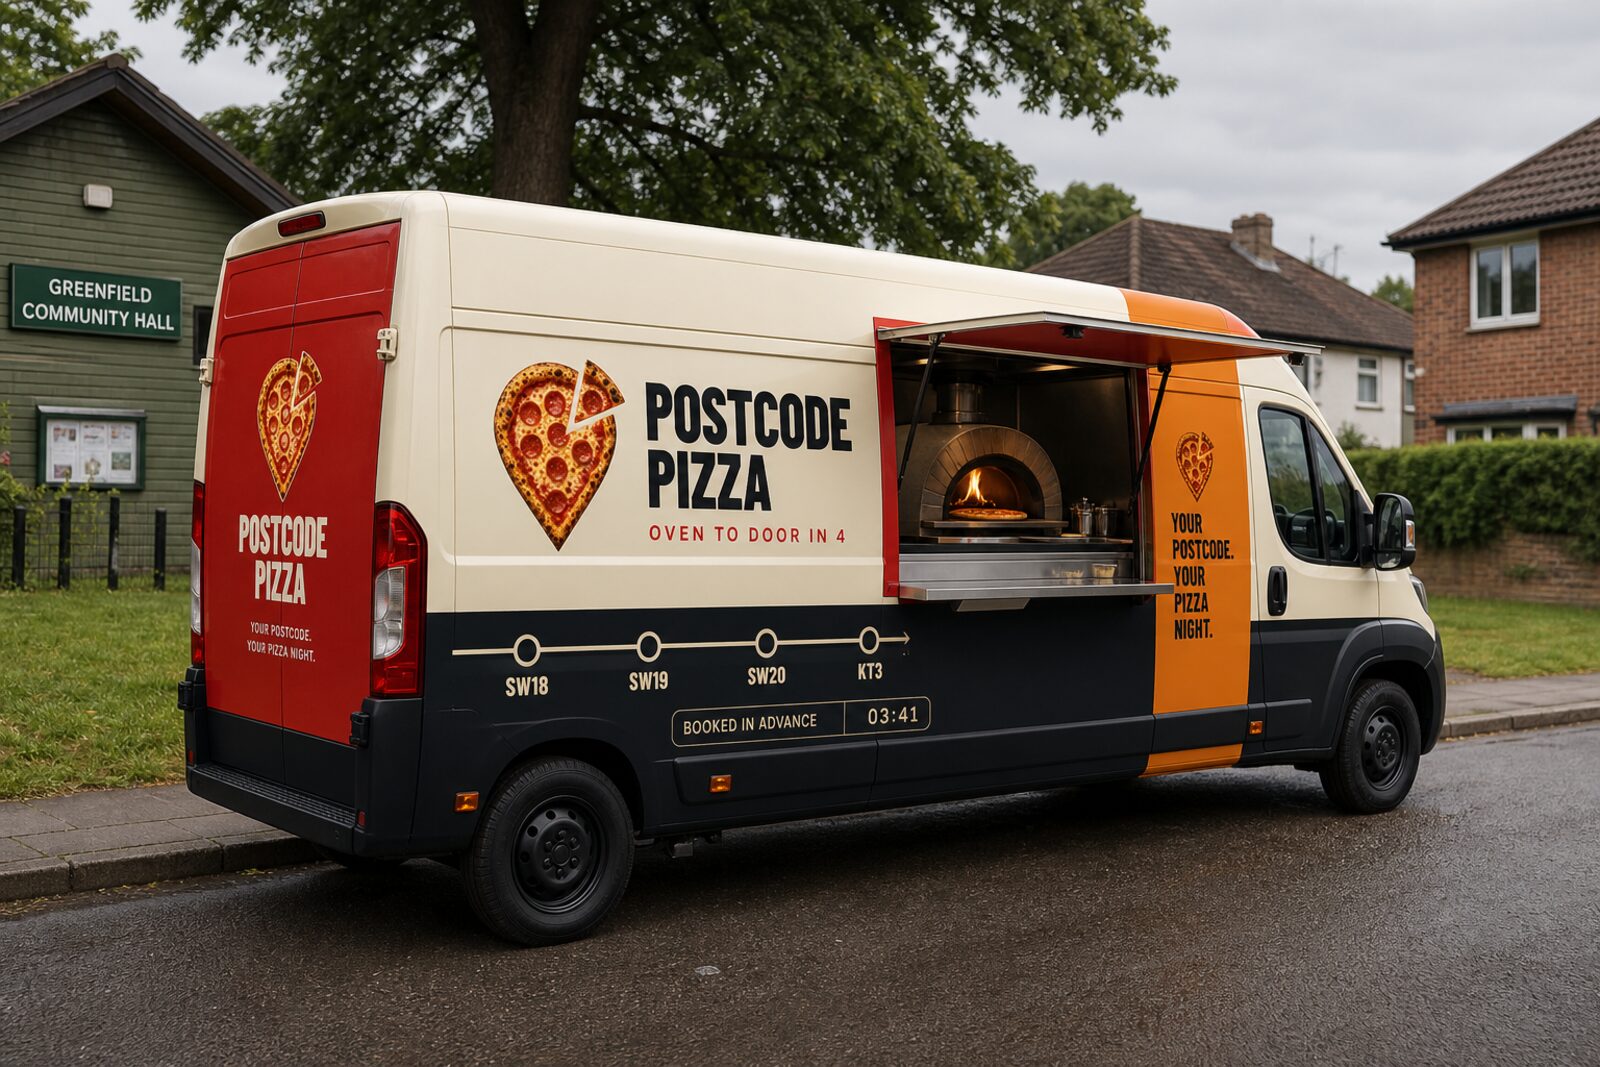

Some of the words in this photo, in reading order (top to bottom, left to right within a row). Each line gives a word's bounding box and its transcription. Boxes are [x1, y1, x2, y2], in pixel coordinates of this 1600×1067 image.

[49, 278, 152, 304] GREENFIELD
[22, 302, 129, 327] COMMUNITY
[134, 312, 175, 331] HALL
[645, 381, 853, 452] POSTCODE
[648, 449, 772, 511] PIZZA
[649, 524, 704, 541] OVEN
[714, 526, 738, 542] TO
[749, 527, 800, 543] DOOR
[809, 528, 827, 543] IN
[836, 529, 845, 543] 4
[1171, 512, 1203, 534] YOUR
[238, 514, 328, 559] POSTCODE
[1172, 539, 1234, 560] POSTCODE.
[254, 559, 307, 605] PIZZA
[1173, 565, 1206, 587] YOUR
[1174, 592, 1209, 613] PIZZA
[250, 621, 269, 636] YOUR
[271, 625, 312, 642] POSTCODE.
[1174, 618, 1213, 640] NIGHT.
[247, 639, 266, 654] YOUR
[268, 643, 289, 658] PIZZA
[290, 647, 316, 663] NIGHT.
[629, 671, 669, 691] SW19
[747, 666, 787, 685] SW20
[857, 662, 883, 680] KT3
[505, 675, 549, 697] SW18
[683, 717, 737, 736] BOOKED
[741, 716, 754, 731] IN
[758, 713, 817, 730] ADVANCE
[868, 706, 918, 725] 03:41
